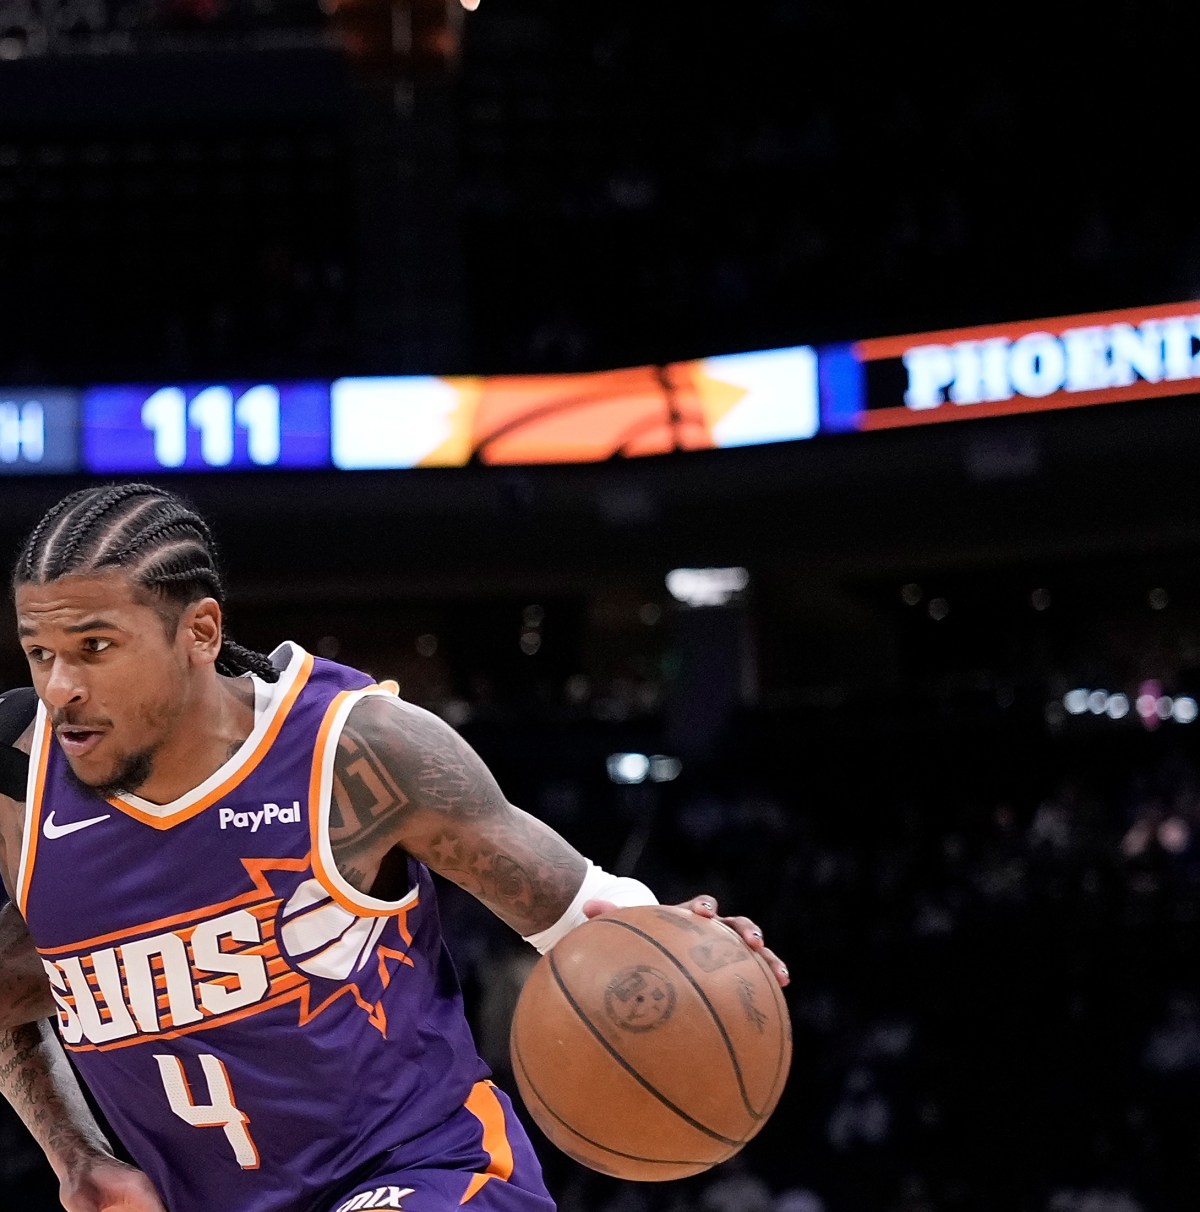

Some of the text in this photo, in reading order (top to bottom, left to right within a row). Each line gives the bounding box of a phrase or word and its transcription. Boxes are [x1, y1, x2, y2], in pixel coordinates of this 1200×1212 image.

[903, 314, 1200, 411] PHOENI
[141, 384, 281, 468] 111
[218, 801, 301, 832] PayPal
[152, 1054, 260, 1170] 4
